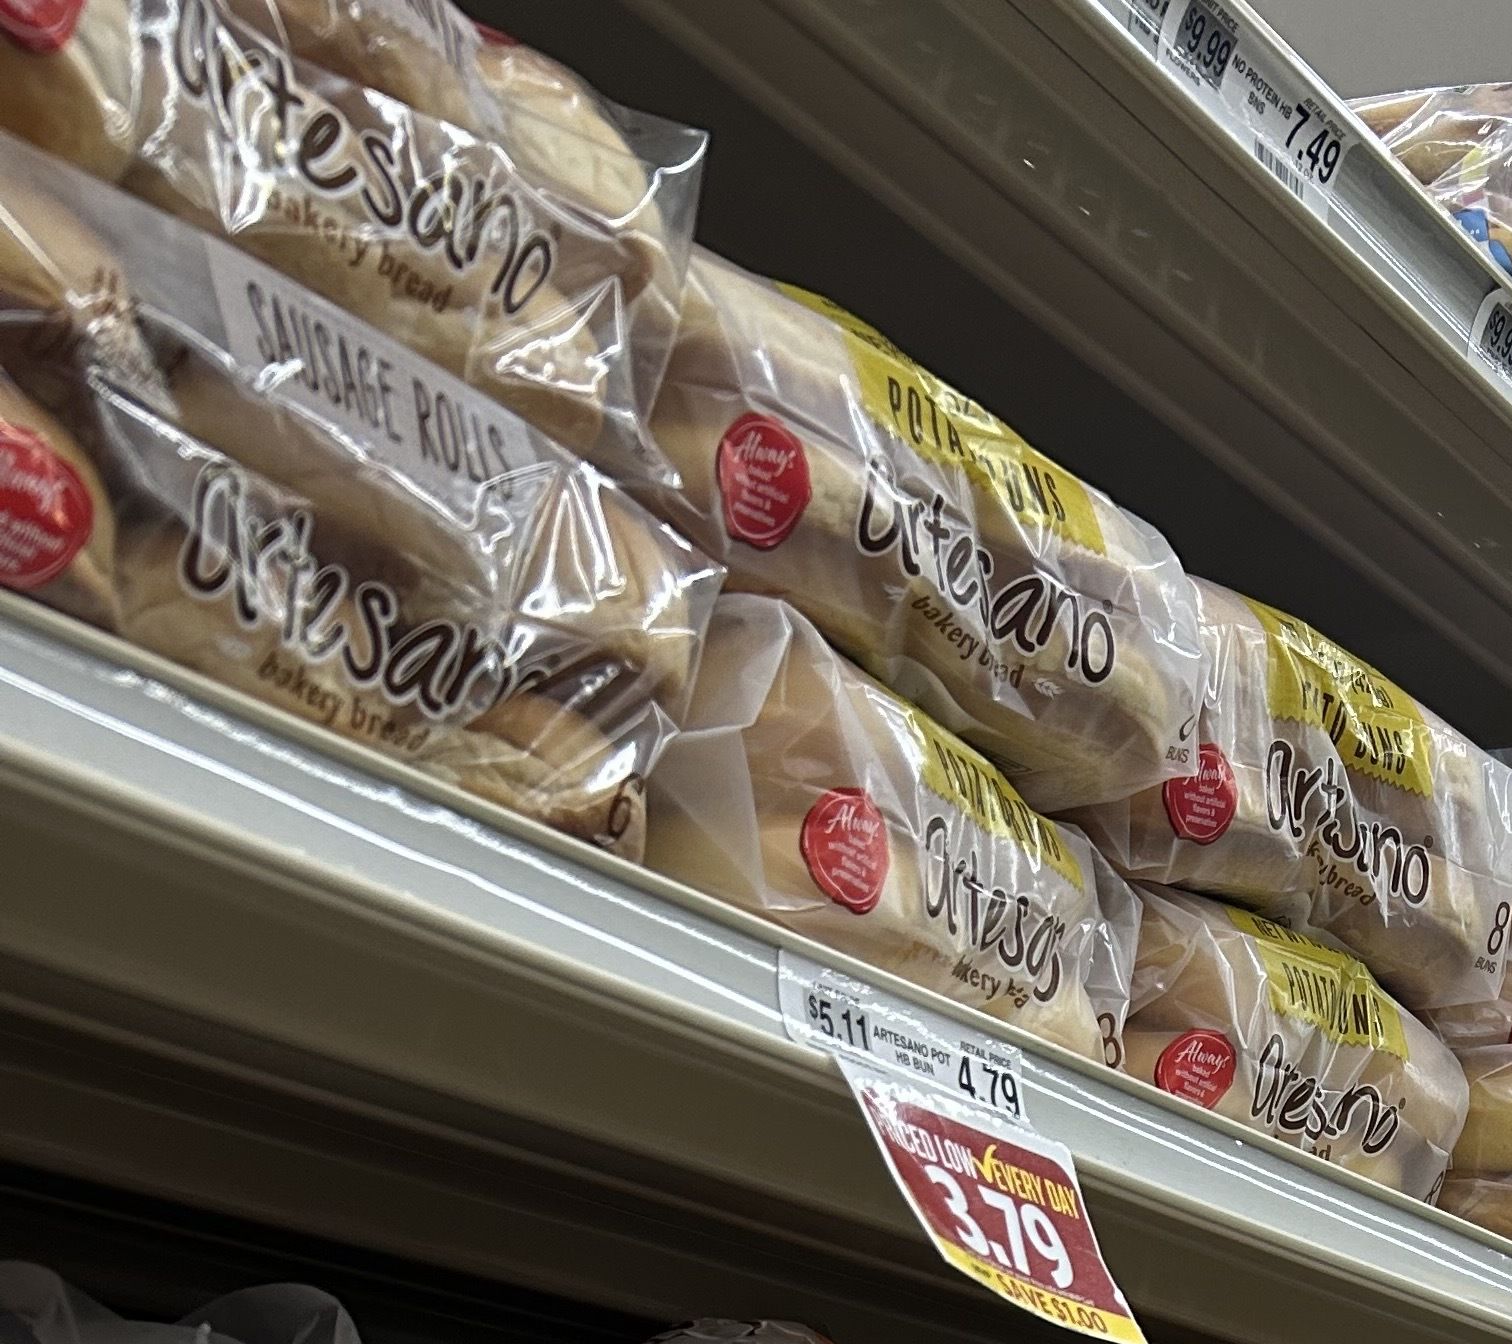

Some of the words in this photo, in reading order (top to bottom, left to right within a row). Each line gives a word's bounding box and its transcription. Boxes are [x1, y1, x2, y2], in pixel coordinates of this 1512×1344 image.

[1184, 7, 1231, 78] $9.99
[1231, 55, 1245, 74] NO
[1245, 67, 1281, 108] PROTEIN
[1285, 103, 1341, 184] 7.49
[379, 246, 452, 313] bread
[246, 281, 401, 441] SAUSAGE
[415, 375, 514, 494] ROLLS
[858, 453, 1116, 685] Artesano
[259, 652, 336, 726] bakery
[349, 696, 429, 754] bread
[1165, 745, 1190, 764] BUNS
[1487, 901, 1510, 955] 8
[1474, 956, 1497, 974] BUNS
[809, 994, 871, 1051] $5.11
[958, 1056, 1020, 1119] 4.79
[1174, 1040, 1229, 1074] Always
[924, 1166, 1075, 1288] 3.79
[997, 1274, 1053, 1316] SAVE
[1054, 1295, 1109, 1334] $1.00
